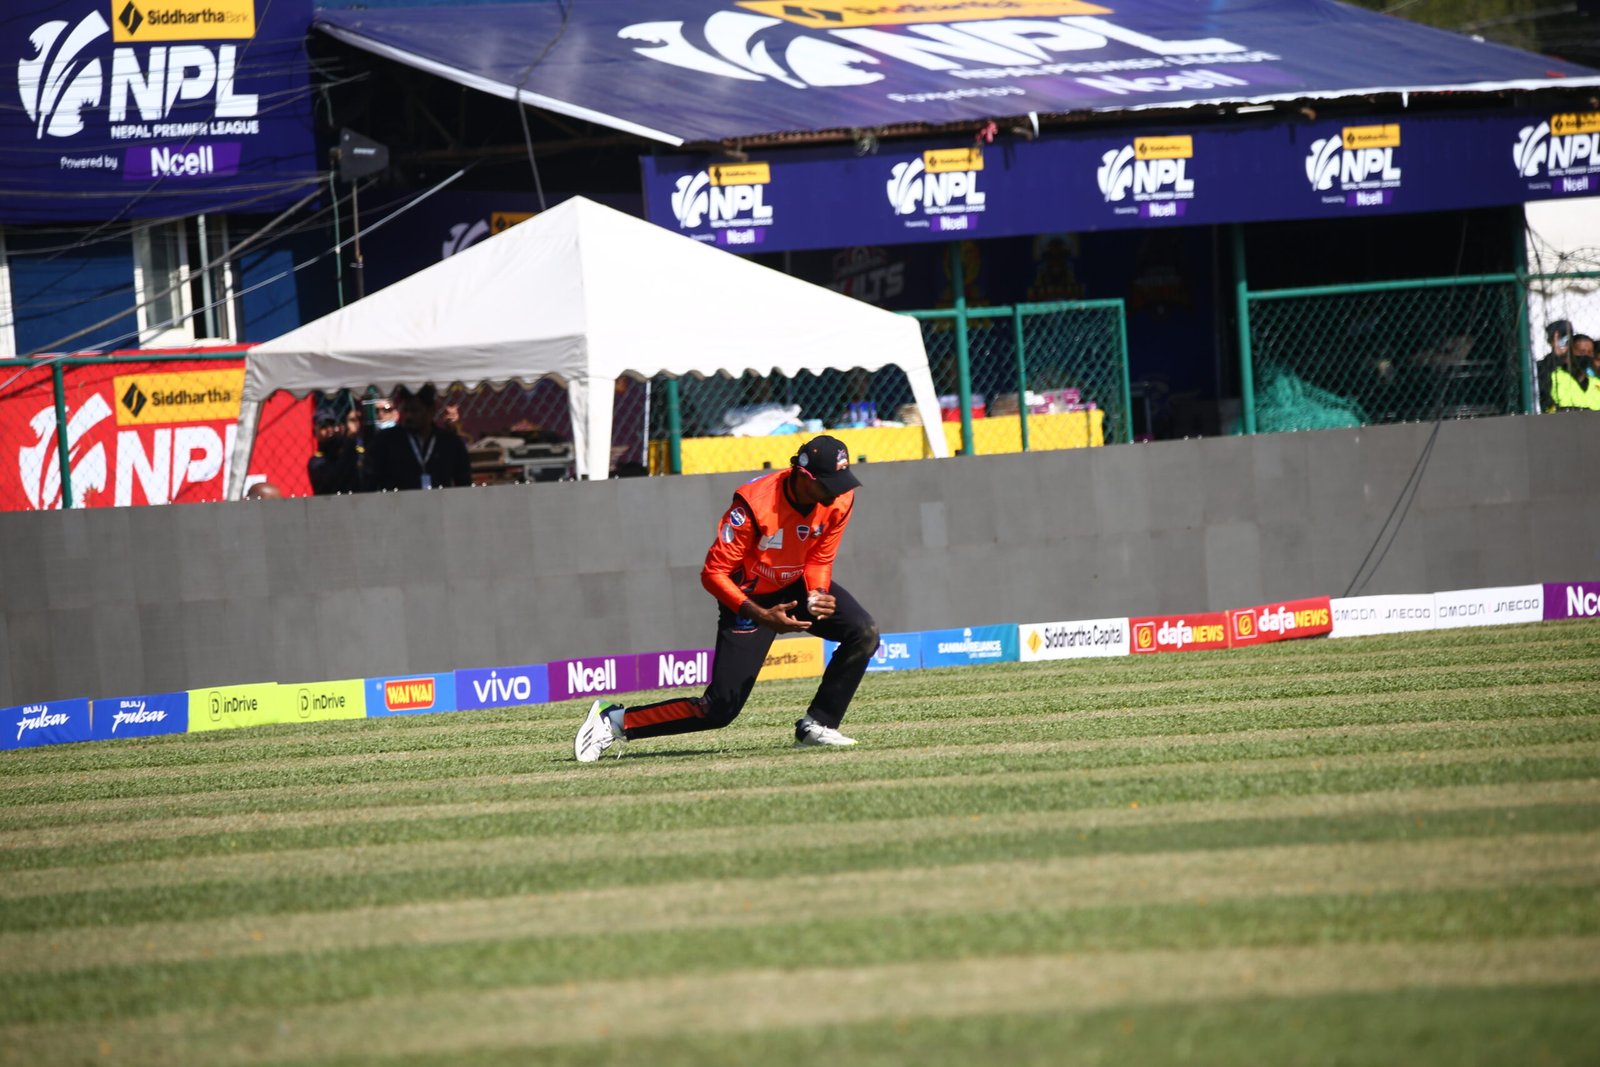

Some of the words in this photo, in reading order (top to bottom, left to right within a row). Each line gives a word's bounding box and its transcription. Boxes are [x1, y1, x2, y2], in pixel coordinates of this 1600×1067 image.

[147, 8, 225, 25] Siddhartha
[827, 15, 1248, 70] NPL
[109, 45, 259, 122] NPL
[1075, 68, 1249, 95] Ncell
[111, 125, 150, 139] NEPAL
[153, 122, 207, 138] PREMIER
[210, 120, 259, 134] LEAGUE
[60, 155, 102, 170] Powered
[104, 156, 118, 170] by
[150, 145, 214, 177] Ncell
[1341, 147, 1402, 183] NPL
[1547, 133, 1600, 170] NPL
[923, 171, 986, 207] NPL
[1133, 158, 1195, 193] NPL
[1563, 176, 1588, 192] Ncell
[709, 184, 773, 220] NPL
[152, 389, 231, 407] Siddhartha
[1044, 626, 1091, 649] Siddhartha
[1093, 622, 1123, 650] Capital
[567, 659, 617, 694] Ncell
[658, 652, 708, 687] Ncell
[313, 692, 345, 710] inDrive
[387, 685, 410, 704] WAI
[410, 683, 433, 703] WAI
[473, 670, 531, 703] vivo
[111, 701, 168, 734] pulsar
[224, 695, 257, 713] inDrive
[17, 706, 70, 741] pulsar
